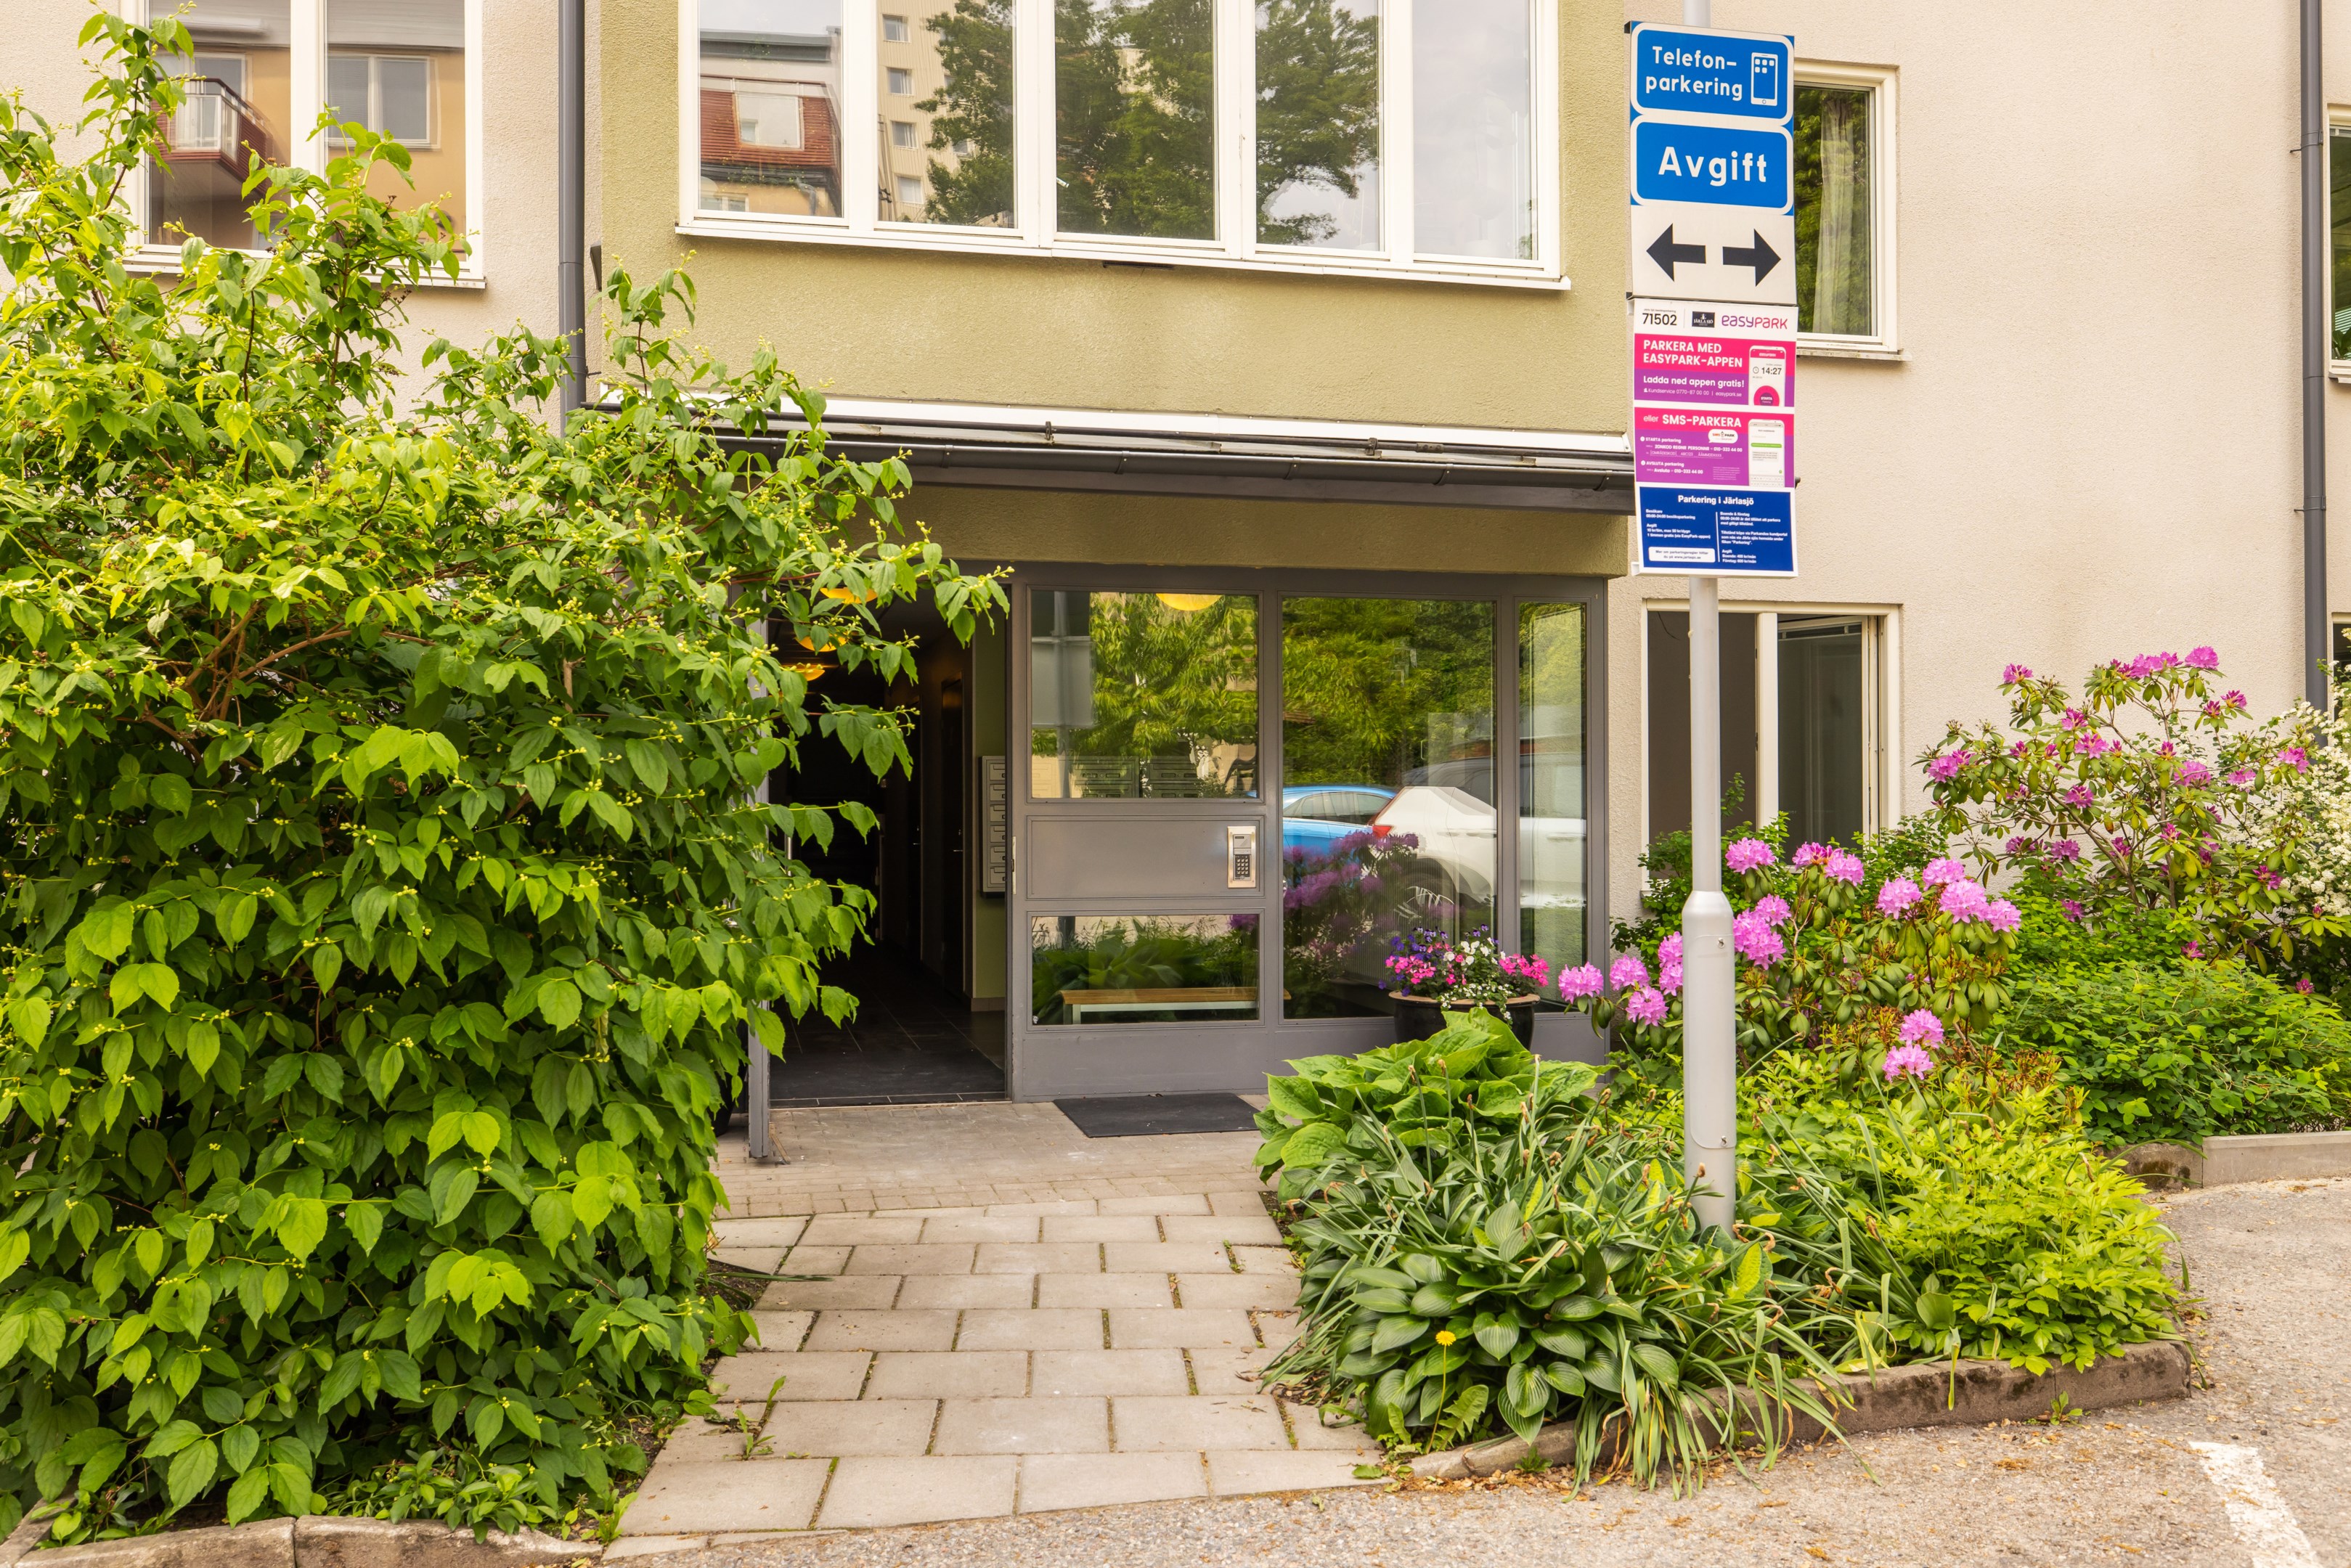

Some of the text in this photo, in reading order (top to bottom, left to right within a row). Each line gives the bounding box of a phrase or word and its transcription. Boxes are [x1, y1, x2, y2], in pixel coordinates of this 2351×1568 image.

[1652, 46, 1737, 70] Telefon-
[1645, 75, 1743, 102] parkering
[1658, 146, 1767, 187] Avgift
[1642, 313, 1677, 326] 71502
[1643, 339, 1722, 354] PARKERA MED
[1643, 353, 1743, 367] EASYPARK-APPEN
[1643, 375, 1668, 384] Ladda
[1689, 378, 1715, 388] appen
[1718, 379, 1744, 388] gratis!
[1662, 415, 1742, 428] SMS-PARKERA
[1678, 495, 1716, 505] Parkering
[1723, 497, 1754, 506] Järlasjö
